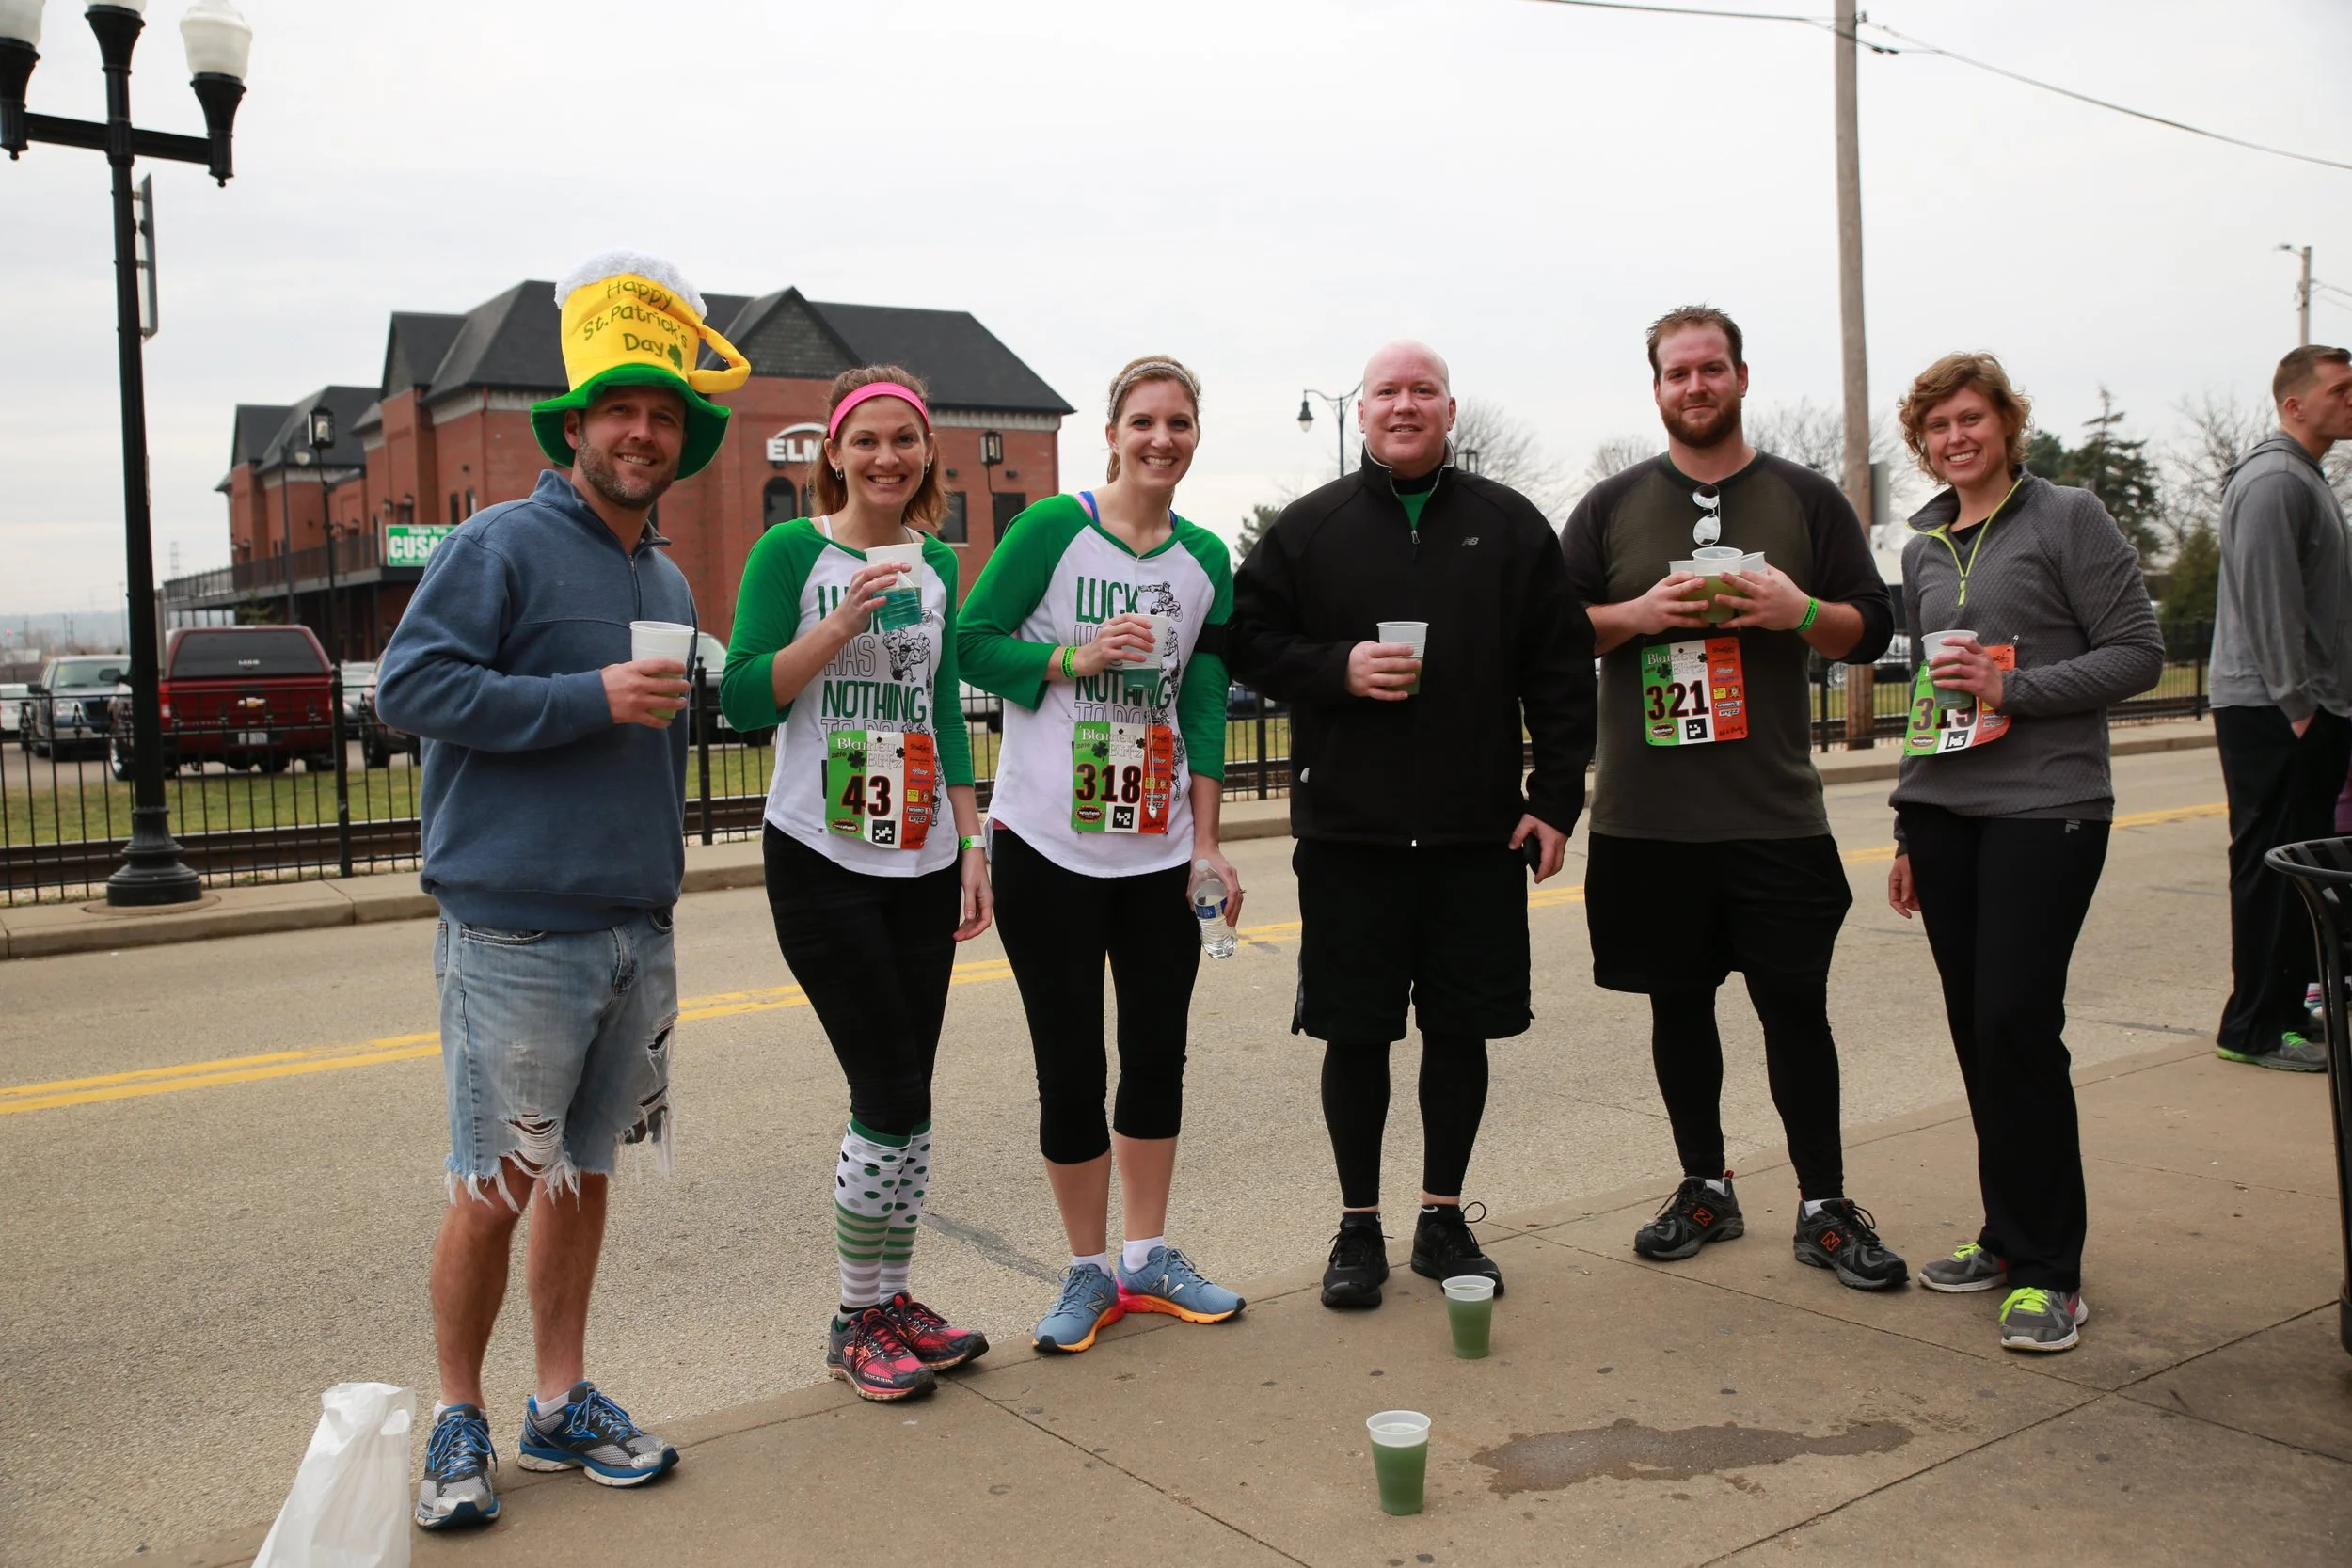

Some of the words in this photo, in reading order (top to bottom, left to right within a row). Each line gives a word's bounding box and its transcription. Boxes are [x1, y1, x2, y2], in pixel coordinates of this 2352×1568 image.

[607, 280, 673, 311] Happy
[583, 316, 609, 341] St.
[610, 305, 688, 349] Patrick's
[623, 332, 664, 358] Day
[1076, 576, 1139, 625] LUCK
[1647, 651, 1699, 665] Blarney
[821, 679, 927, 723] NOTHING
[1646, 679, 1710, 721] 321
[837, 737, 897, 753] Blarney
[1082, 728, 1137, 745] Blarney
[840, 774, 892, 817] 43
[1074, 762, 1142, 804] 318
